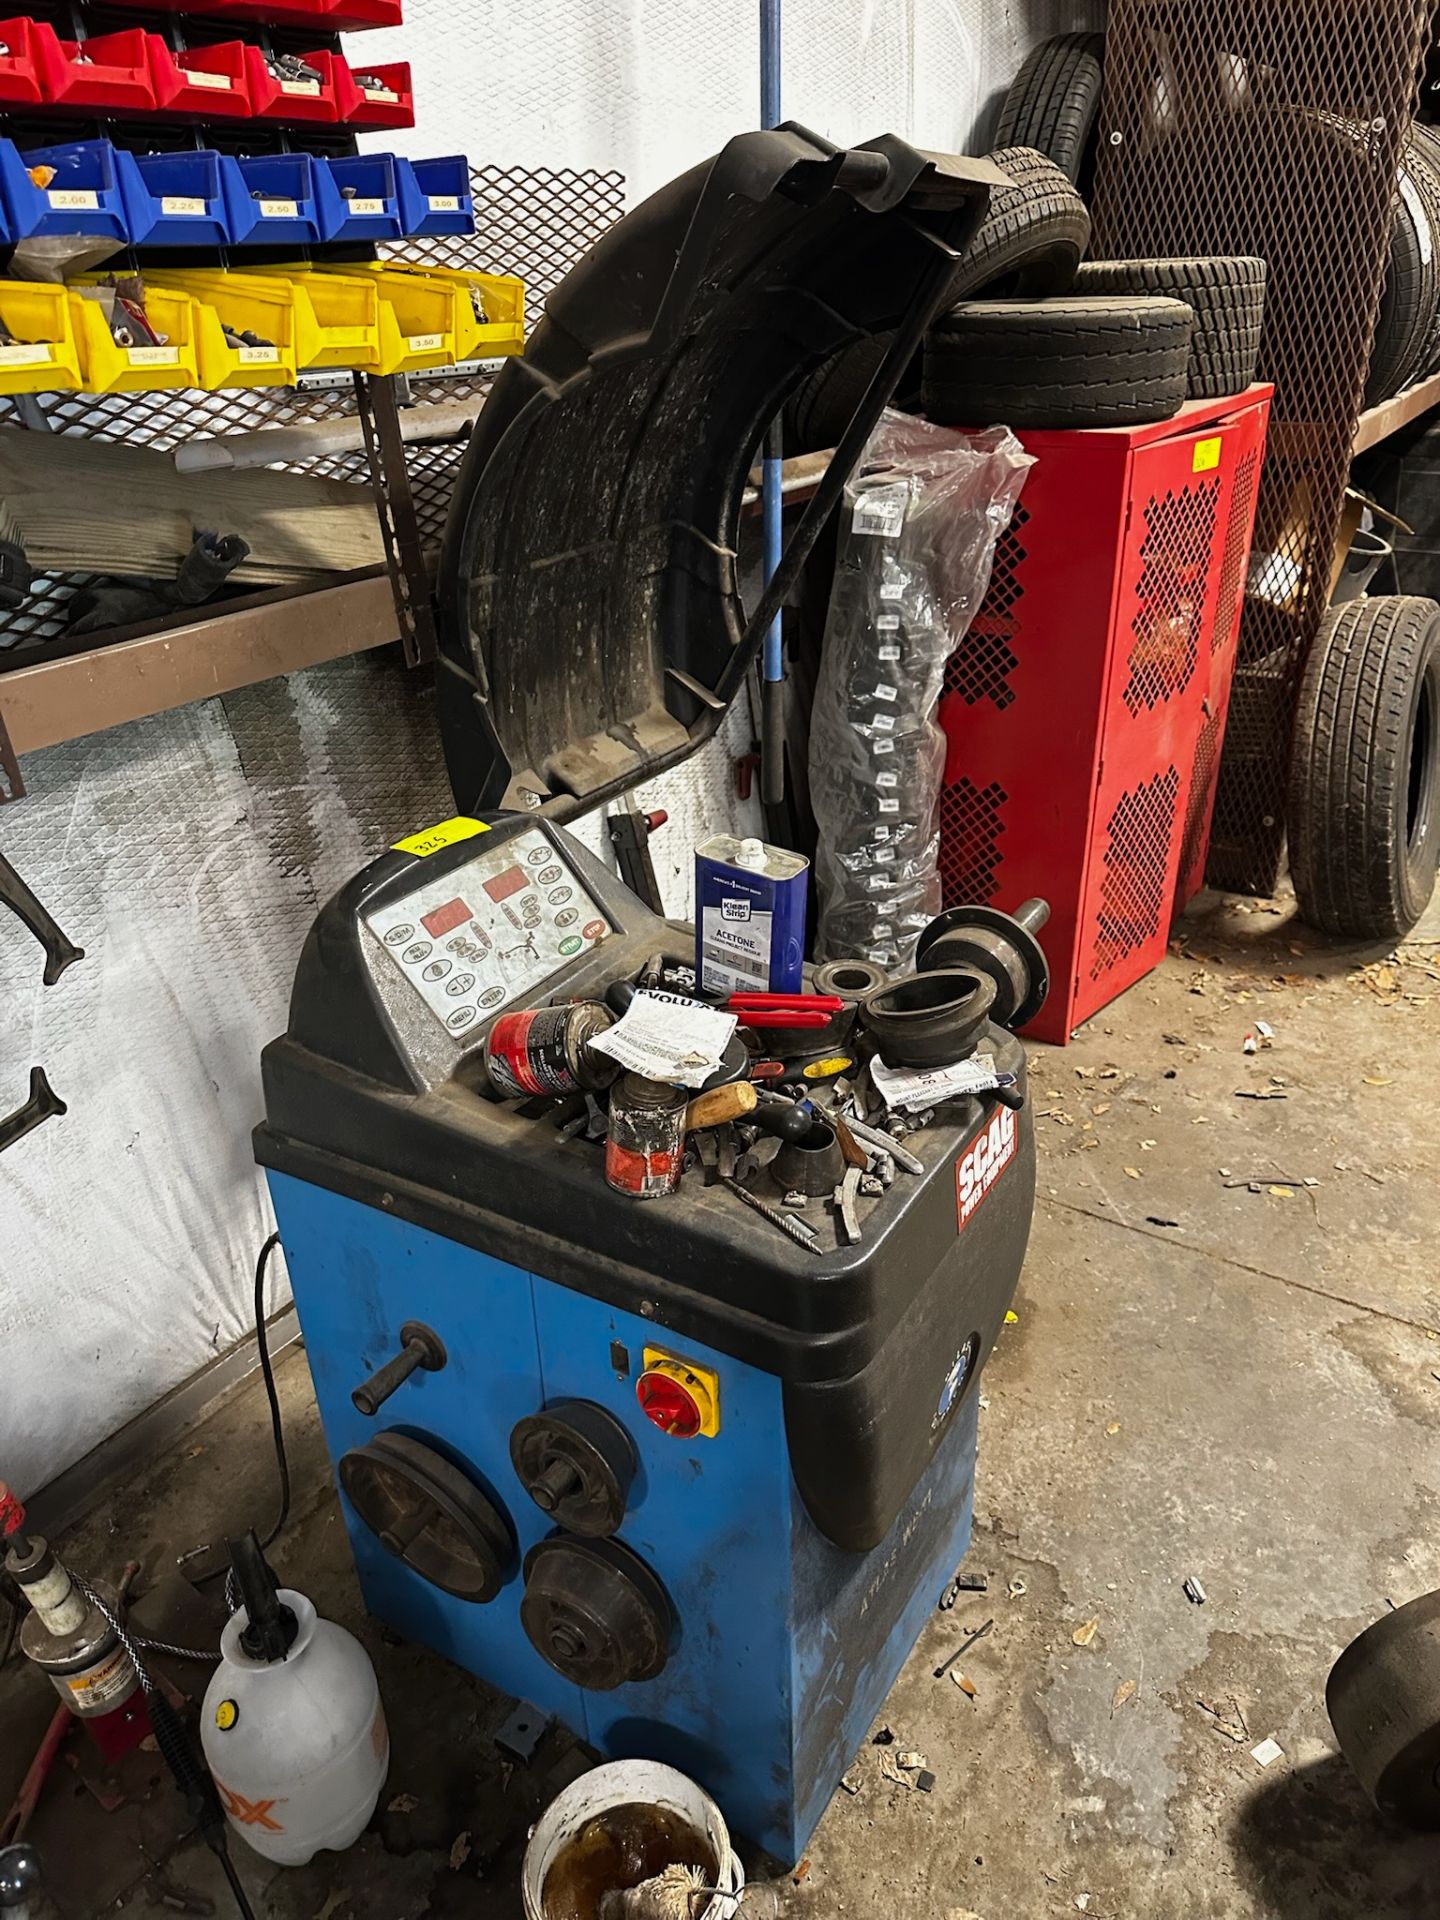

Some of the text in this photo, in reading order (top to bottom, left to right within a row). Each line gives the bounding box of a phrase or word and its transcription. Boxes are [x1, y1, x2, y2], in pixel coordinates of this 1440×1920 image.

[59, 195, 86, 205] 2.00
[434, 200, 452, 208] 3.00
[170, 202, 195, 211] 2.25
[268, 205, 290, 214] 2.50
[355, 203, 375, 211] 2.75
[415, 338, 434, 348] 3.50
[247, 351, 270, 359] 3.25
[414, 836, 447, 851] 325
[723, 902, 749, 911] Klean
[725, 910, 746, 919] Strip
[586, 923, 601, 936] STOP
[716, 929, 756, 949] ACETONE
[560, 938, 580, 953] START
[480, 989, 503, 1006] ENTER
[451, 1009, 472, 1026] MENU
[959, 1105, 1015, 1203] SCAG
[960, 1181, 983, 1224] POWER
